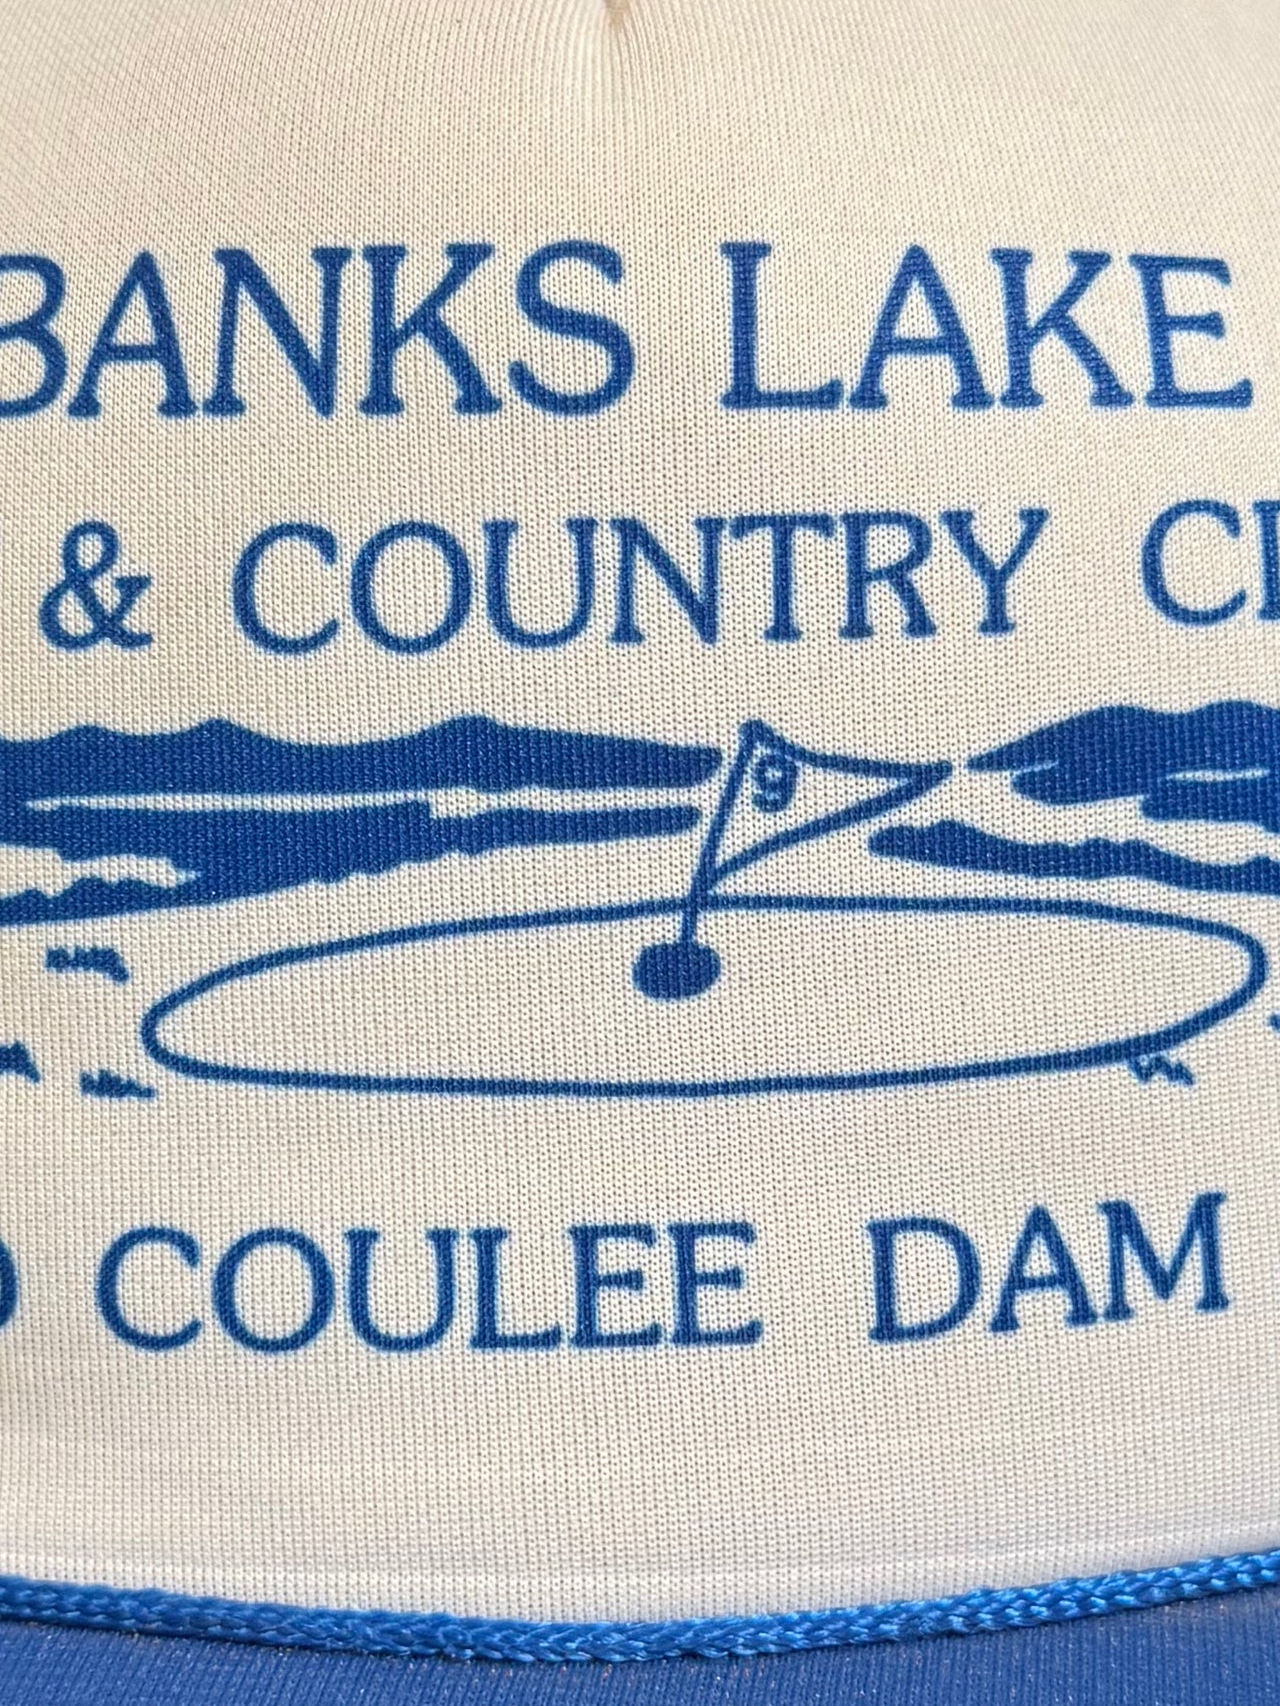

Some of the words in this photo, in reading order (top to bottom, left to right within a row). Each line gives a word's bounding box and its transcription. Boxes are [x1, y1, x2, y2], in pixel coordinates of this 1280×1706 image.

[720, 242, 1253, 412] LAKE
[39, 521, 152, 652] &
[232, 508, 1048, 656] COUNTRY
[95, 1221, 763, 1356] COULEE
[866, 1191, 1230, 1344] DAM
